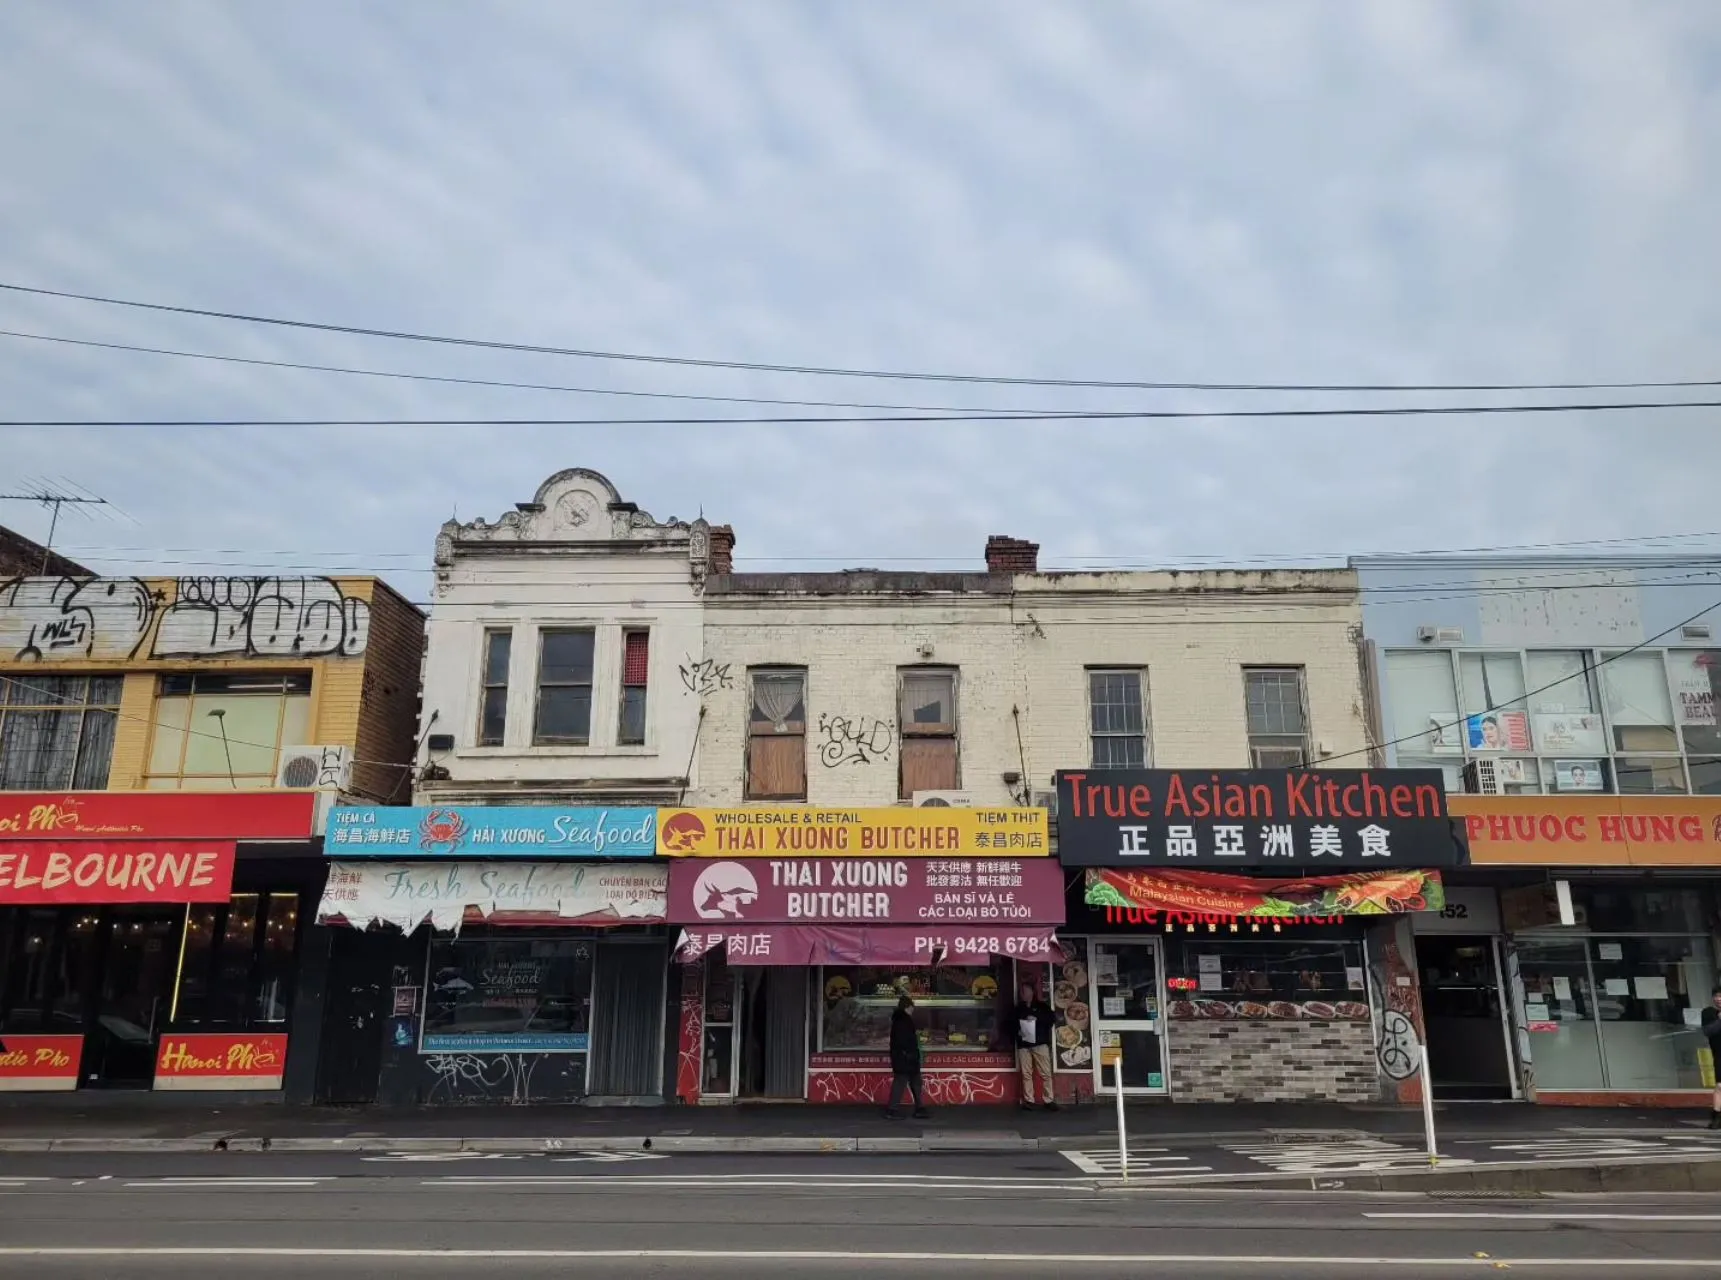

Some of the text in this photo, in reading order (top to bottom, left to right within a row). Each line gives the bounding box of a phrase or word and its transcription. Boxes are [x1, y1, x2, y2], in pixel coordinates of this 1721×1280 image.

[1064, 772, 1441, 818] True Asian Kitchen
[548, 810, 653, 852] Seafood
[715, 813, 862, 824] WHOLESALE & RETAIL
[976, 812, 1007, 826] TIỆM
[1466, 815, 1587, 842] PHUOC
[1598, 815, 1704, 842] HUNG
[715, 826, 960, 850] THAI XUONG BUTCHER
[975, 832, 1042, 848] 泰昌肉店
[1118, 824, 1391, 858] 正品亞洲美食
[0, 852, 218, 891] ELBOURNE
[384, 863, 585, 905] Fresh Seafood
[770, 861, 908, 887] THAI XUONG
[787, 892, 889, 918] BUTCHER
[1129, 885, 1194, 905] Malaysian
[1196, 895, 1244, 909] Cuisine
[954, 937, 1000, 954] 9428
[1006, 937, 1050, 954] 6784
[32, 1048, 70, 1067] Pho
[160, 1041, 222, 1071] Hanoi
